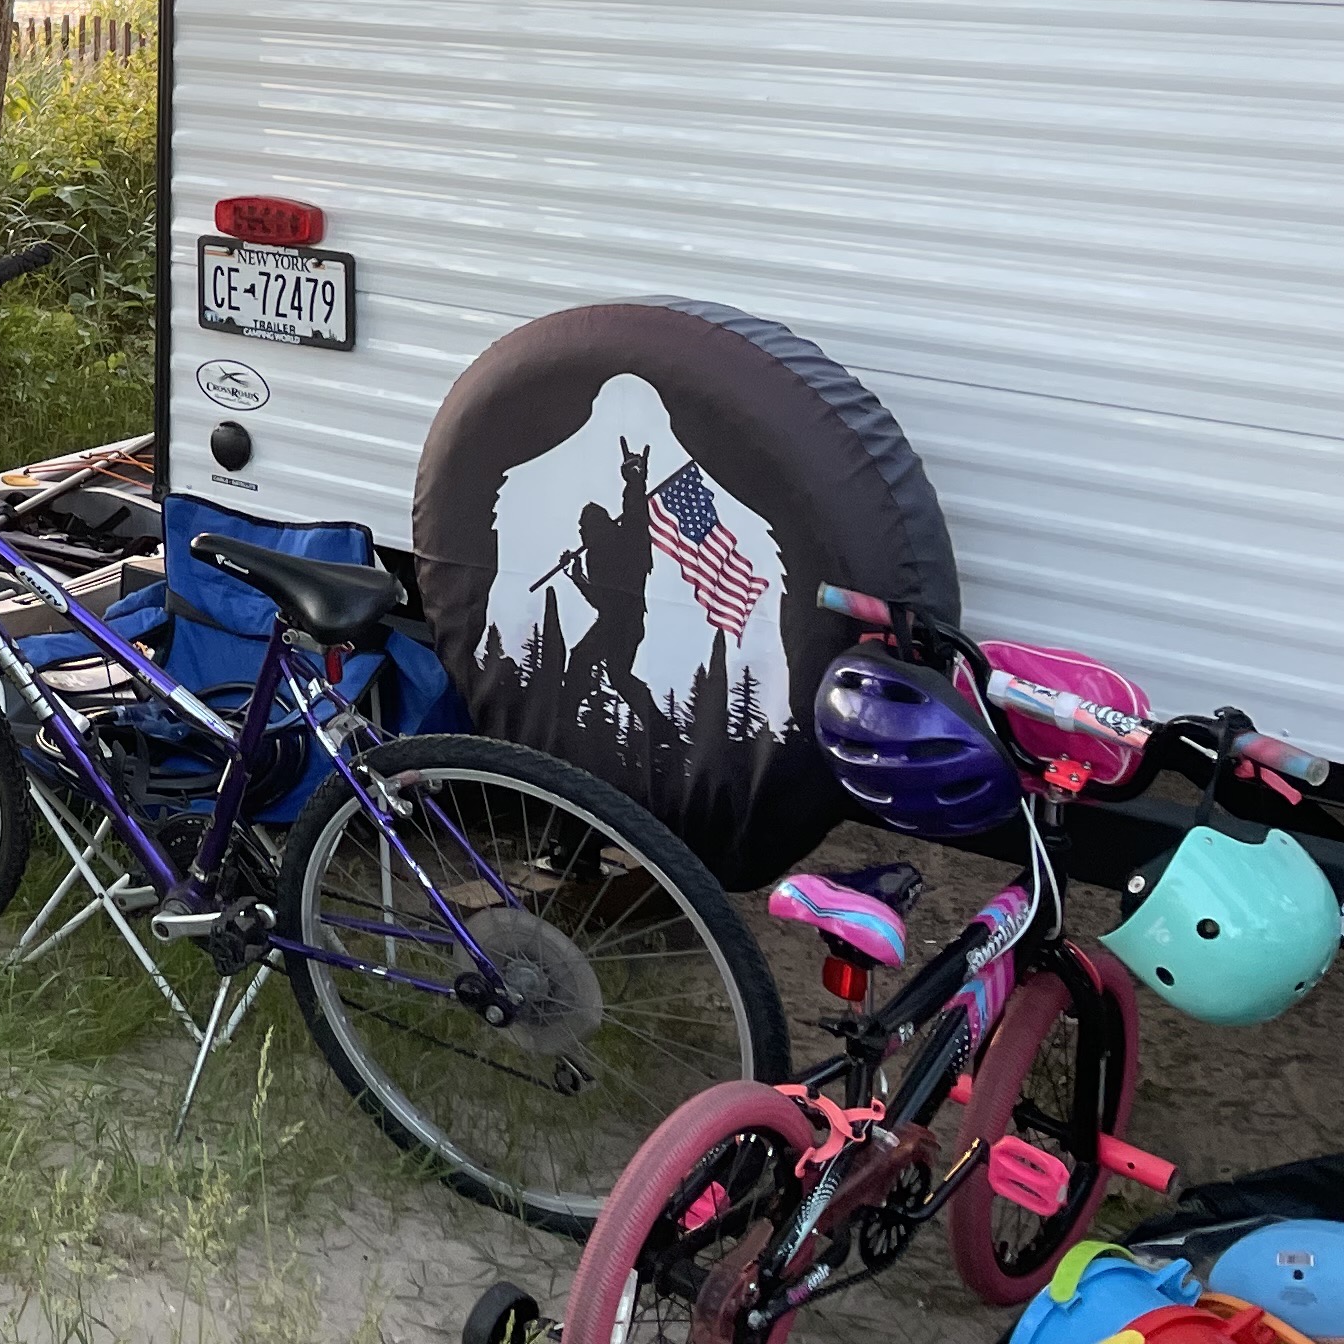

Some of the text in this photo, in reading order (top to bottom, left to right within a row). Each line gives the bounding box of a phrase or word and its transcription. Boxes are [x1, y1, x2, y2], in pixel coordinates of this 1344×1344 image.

[237, 249, 311, 273] NEW YORK
[213, 265, 335, 323] CE 72479
[253, 319, 296, 335] TRAILER
